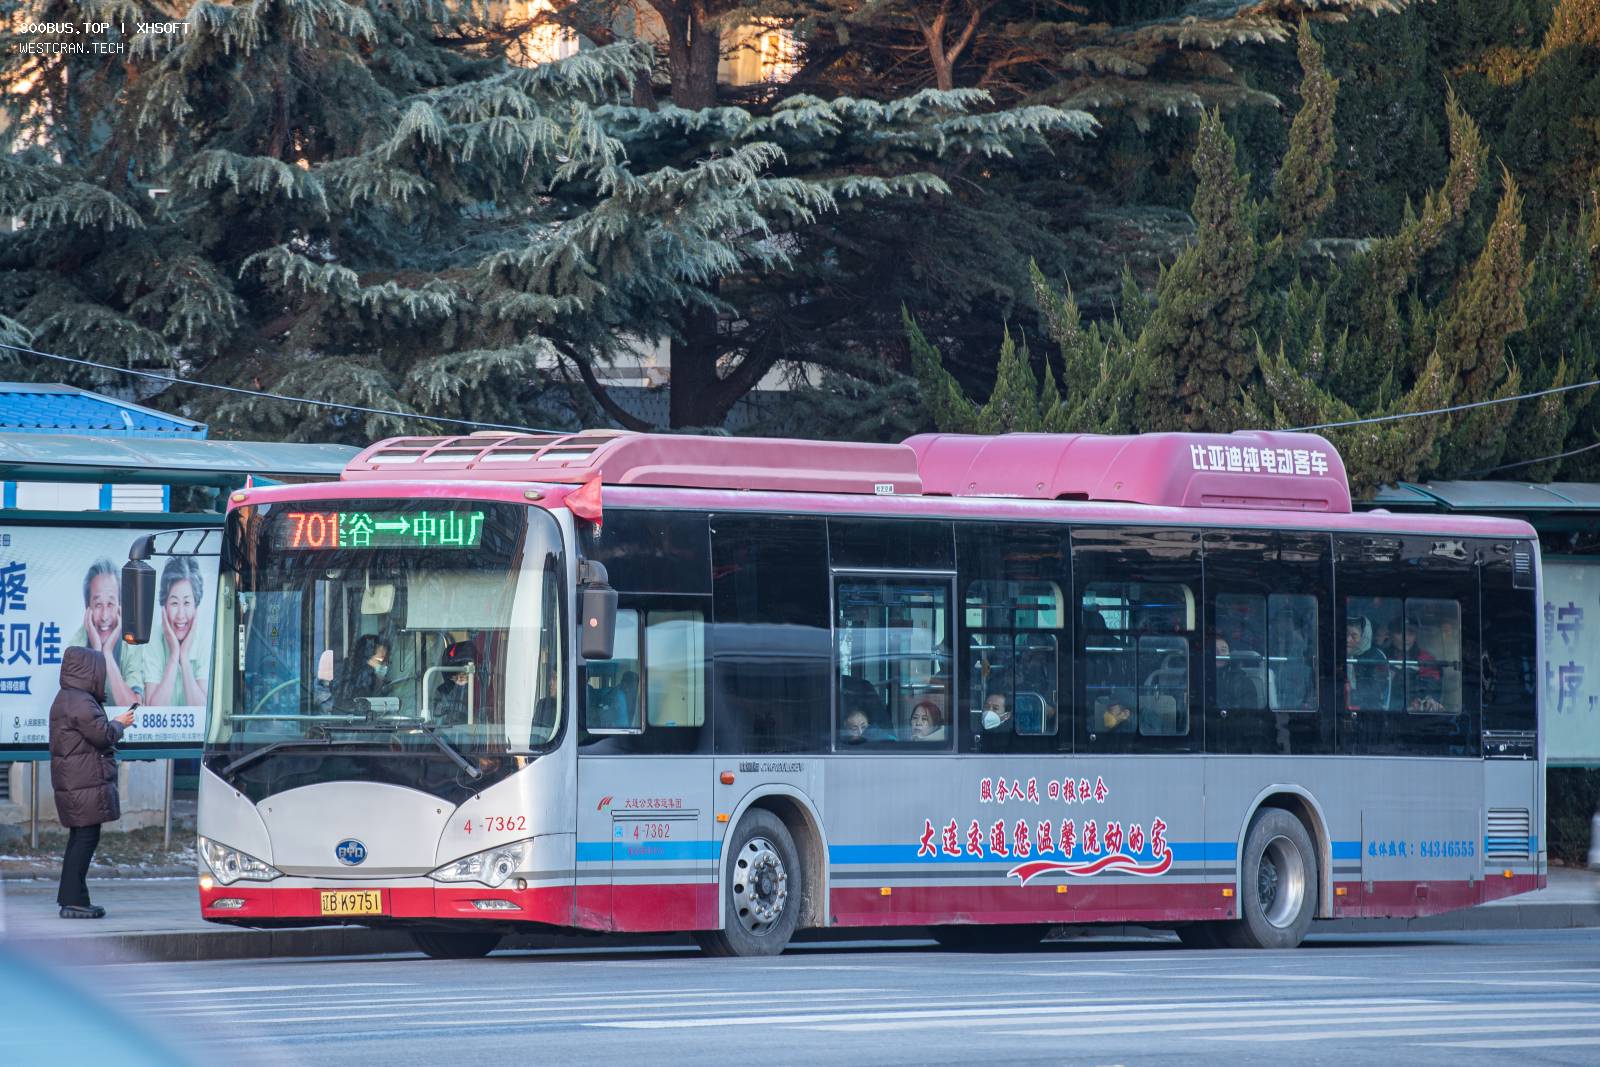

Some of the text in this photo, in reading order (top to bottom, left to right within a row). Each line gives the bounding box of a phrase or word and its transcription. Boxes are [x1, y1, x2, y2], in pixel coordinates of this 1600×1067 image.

[1190, 444, 1329, 476] 比亚迪纯电动客车
[287, 512, 338, 547] 701
[0, 621, 62, 666] 贝佳
[142, 713, 195, 729] 8886 5533
[980, 775, 1109, 805] 服务人民 回报社会
[917, 815, 1168, 858] 大连交通您温馨流动的家
